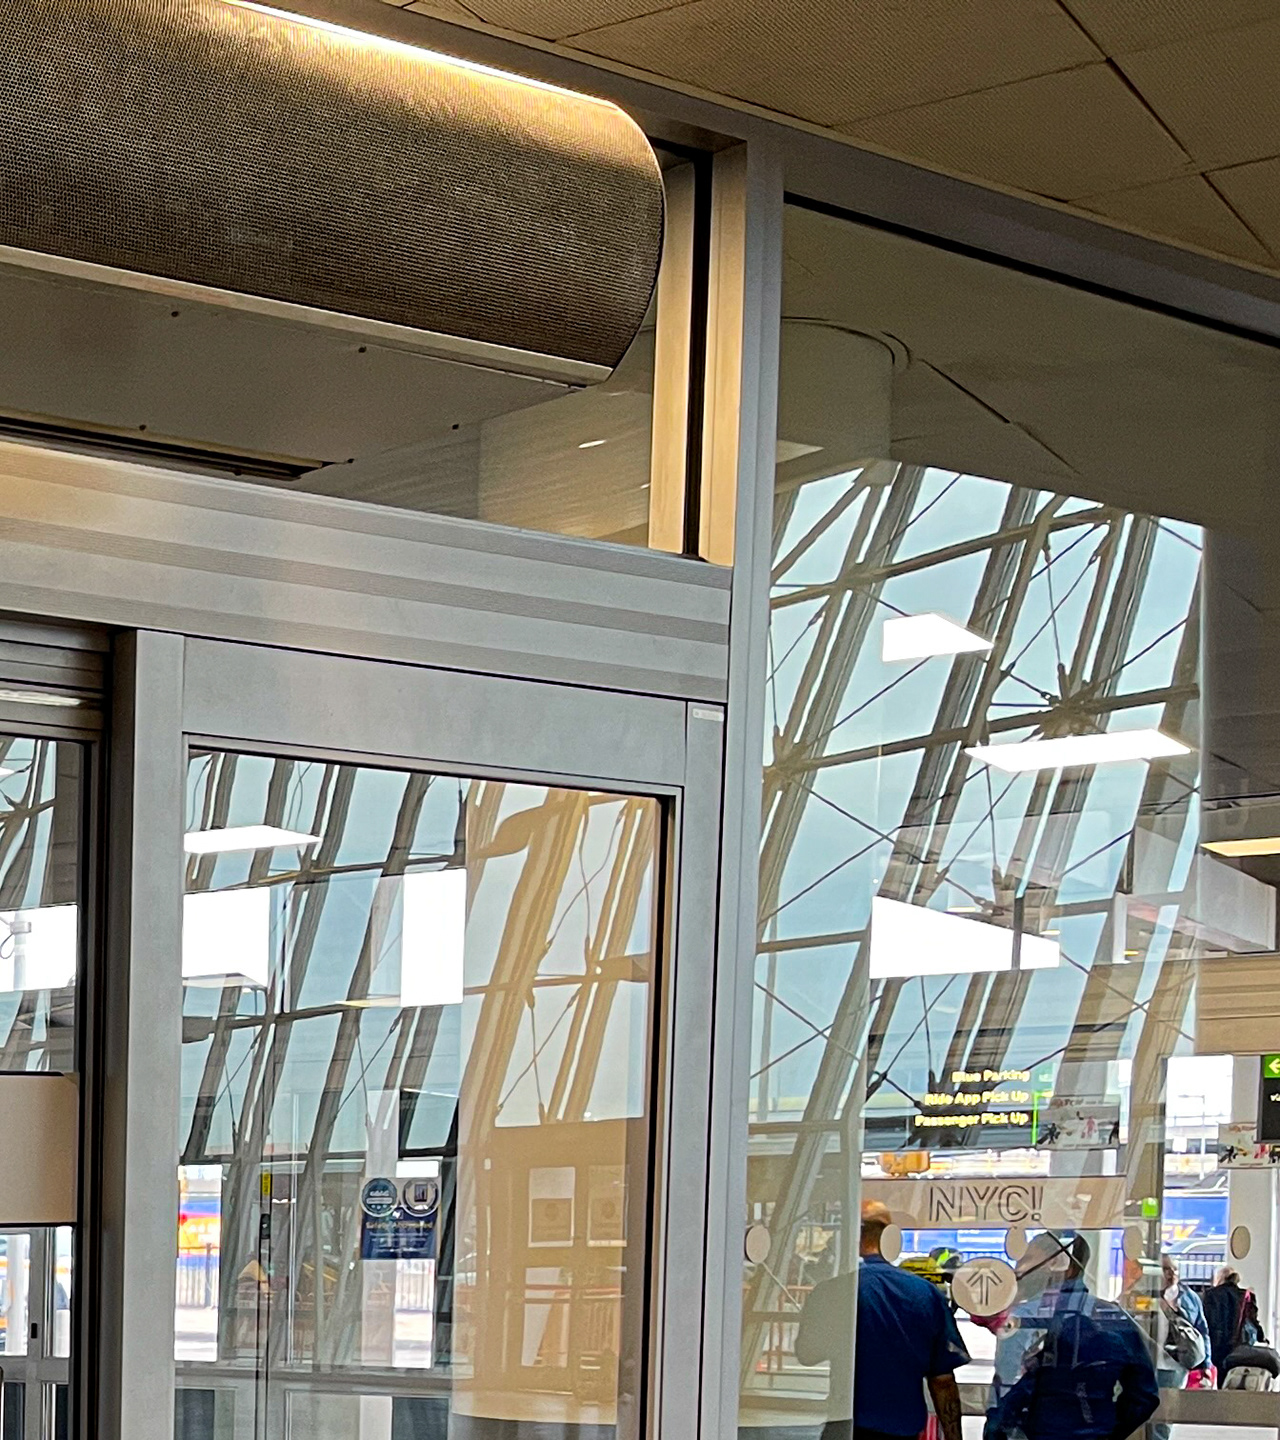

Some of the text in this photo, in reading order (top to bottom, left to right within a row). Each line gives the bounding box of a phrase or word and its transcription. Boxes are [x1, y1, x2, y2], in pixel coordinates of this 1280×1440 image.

[983, 1069, 1031, 1083] Parking
[924, 1090, 1029, 1106] Ride App Pick Up
[914, 1112, 1029, 1127] Passenger Pick Up
[929, 1185, 1044, 1223] NYC!
